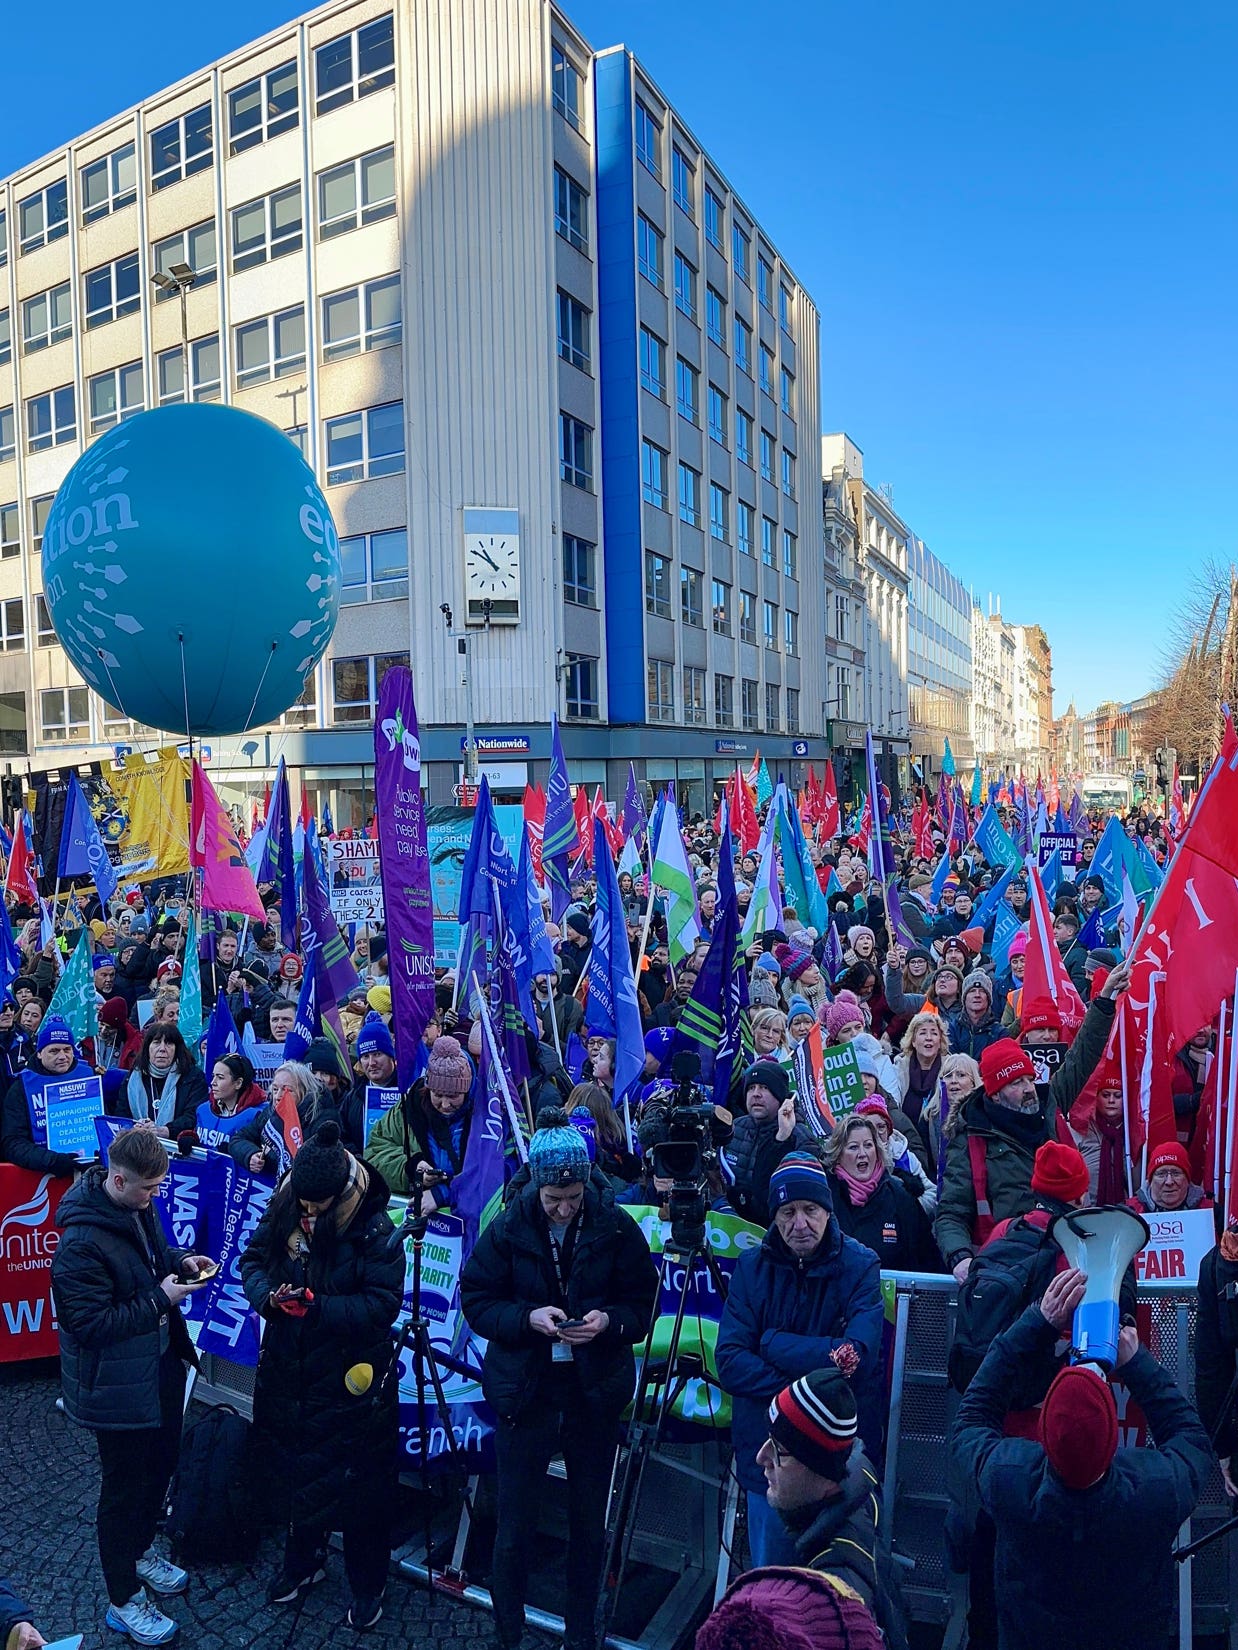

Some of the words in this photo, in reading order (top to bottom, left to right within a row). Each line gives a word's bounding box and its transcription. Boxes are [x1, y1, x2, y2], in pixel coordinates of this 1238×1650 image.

[478, 738, 527, 749] Nationwide
[1040, 837, 1076, 848] OFFICIAL
[332, 841, 380, 859] SHAM
[1043, 850, 1073, 861] PIKET
[337, 899, 348, 908] IF
[356, 898, 381, 908] ONLY
[333, 910, 364, 921] THESE
[365, 907, 377, 919] 2
[1029, 1014, 1048, 1025] nipsa
[995, 1061, 1025, 1080] nipsa
[59, 1083, 87, 1094] NASUWT
[826, 1074, 844, 1092] in
[846, 1073, 857, 1086] a
[50, 1104, 100, 1119] CAMPAIGNING
[51, 1118, 66, 1128] FOR
[67, 1118, 74, 1126] A
[59, 1127, 78, 1137] DEAL
[78, 1125, 93, 1134] FOR
[58, 1134, 95, 1146] TEACHERS
[1154, 1154, 1178, 1165] nipsa
[233, 1177, 249, 1203] The
[405, 1237, 452, 1265] RSTORE
[1135, 1249, 1186, 1281] FAIR
[427, 1308, 447, 1320] NOW!
